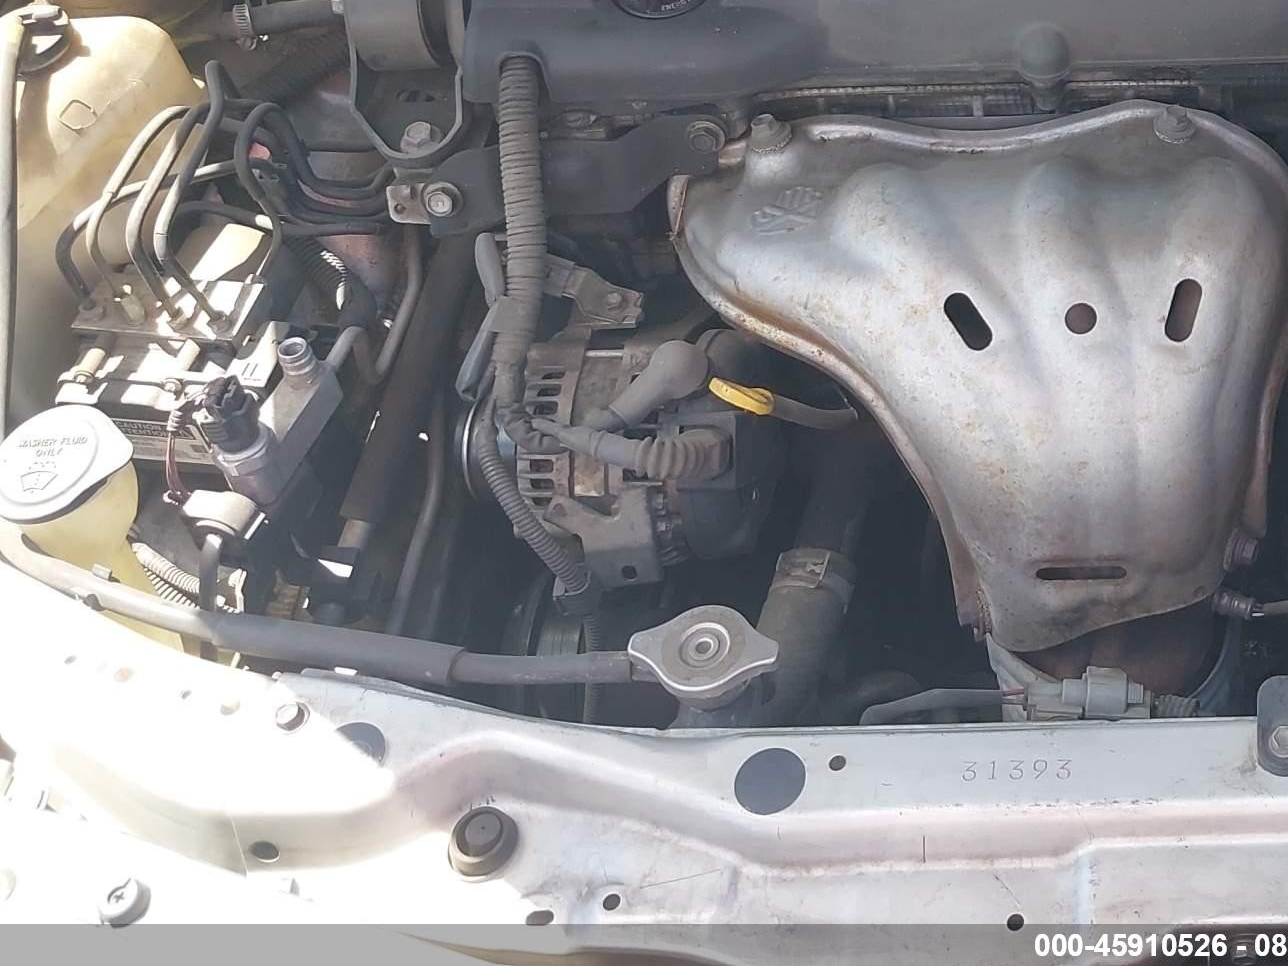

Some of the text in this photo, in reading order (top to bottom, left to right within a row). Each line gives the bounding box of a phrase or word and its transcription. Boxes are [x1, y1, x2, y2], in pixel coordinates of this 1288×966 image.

[59, 435, 89, 446] FLUID
[35, 447, 64, 458] ONLY
[961, 759, 1073, 782] 31393
